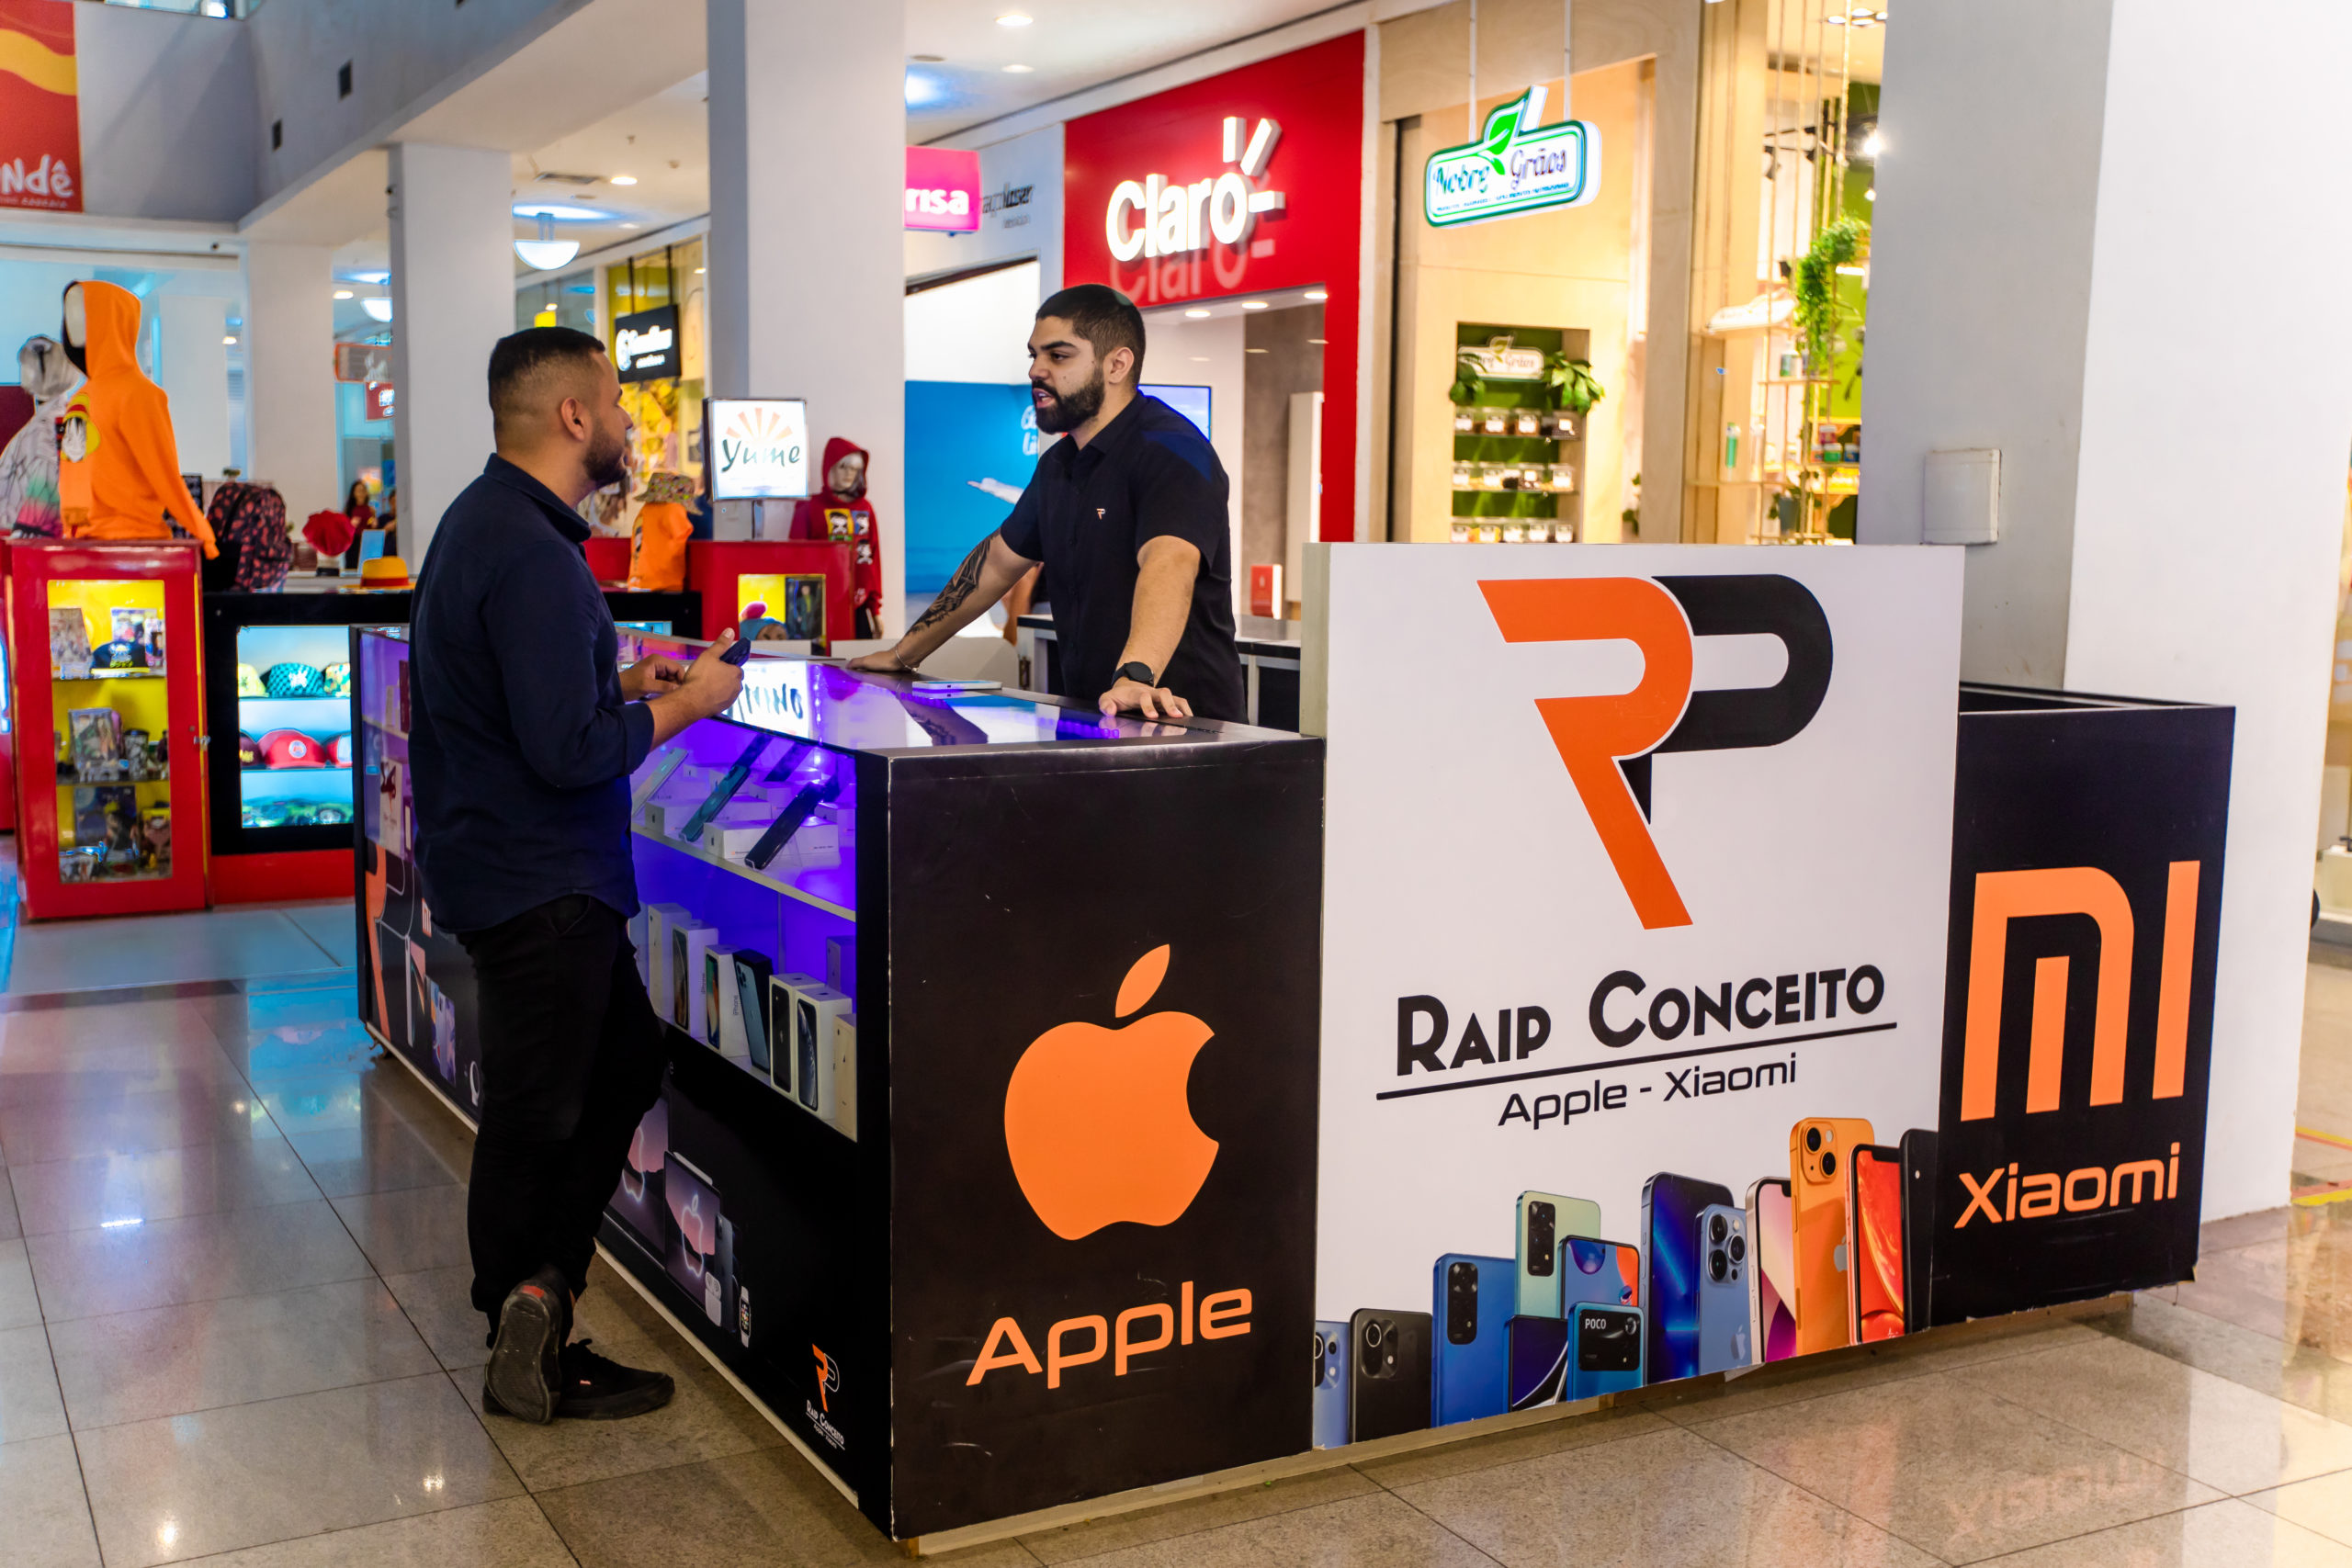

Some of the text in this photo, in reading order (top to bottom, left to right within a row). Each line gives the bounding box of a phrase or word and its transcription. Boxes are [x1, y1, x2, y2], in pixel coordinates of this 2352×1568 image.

[0, 153, 74, 198] Ndê
[1106, 172, 1255, 261] Claro
[1498, 1079, 1627, 1130] Apple
[1664, 1053, 1796, 1101] Xiaomi
[1955, 1143, 2180, 1229] Xiaomi
[967, 1281, 1252, 1390] Apple
[1585, 1318, 1607, 1329] POCO
